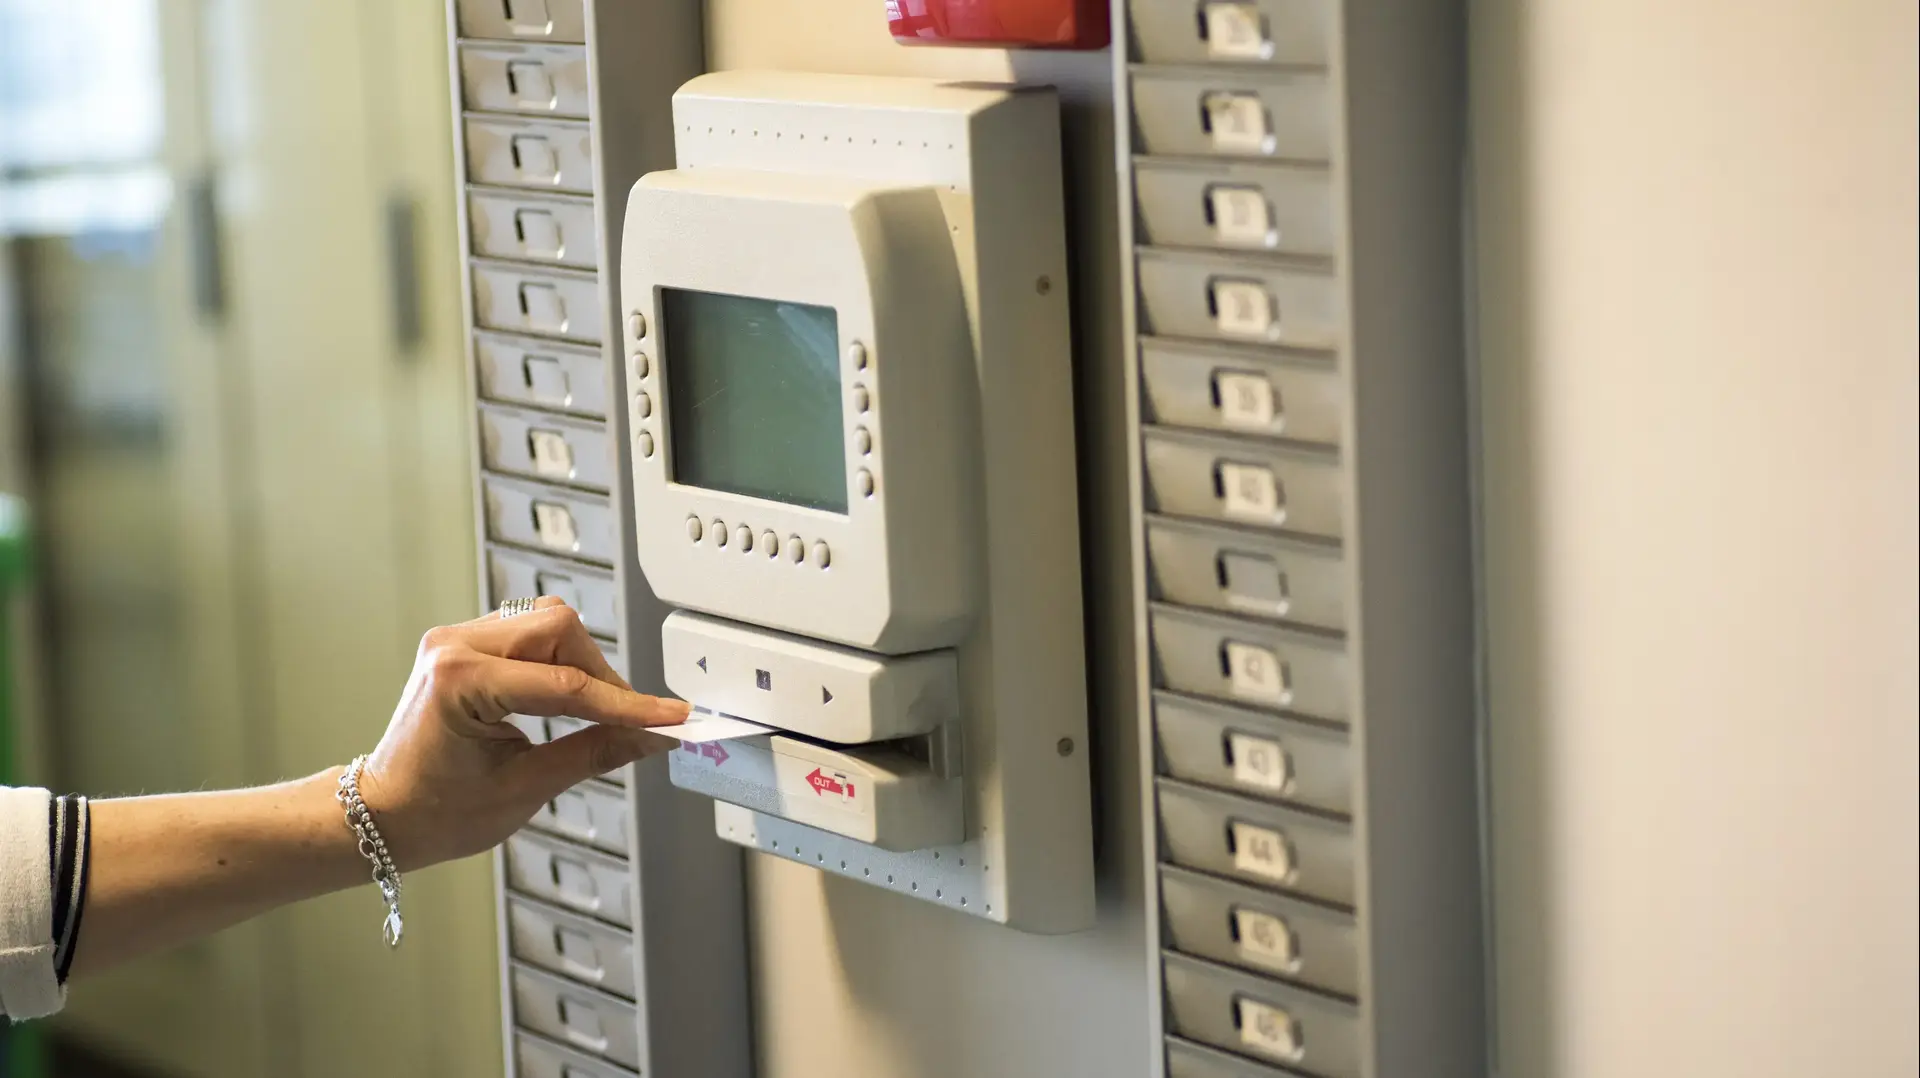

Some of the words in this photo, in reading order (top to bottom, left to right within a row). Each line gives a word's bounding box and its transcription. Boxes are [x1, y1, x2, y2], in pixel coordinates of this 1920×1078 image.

[712, 748, 722, 758] IN
[814, 776, 831, 788] OUT
[1249, 835, 1273, 864] 44
